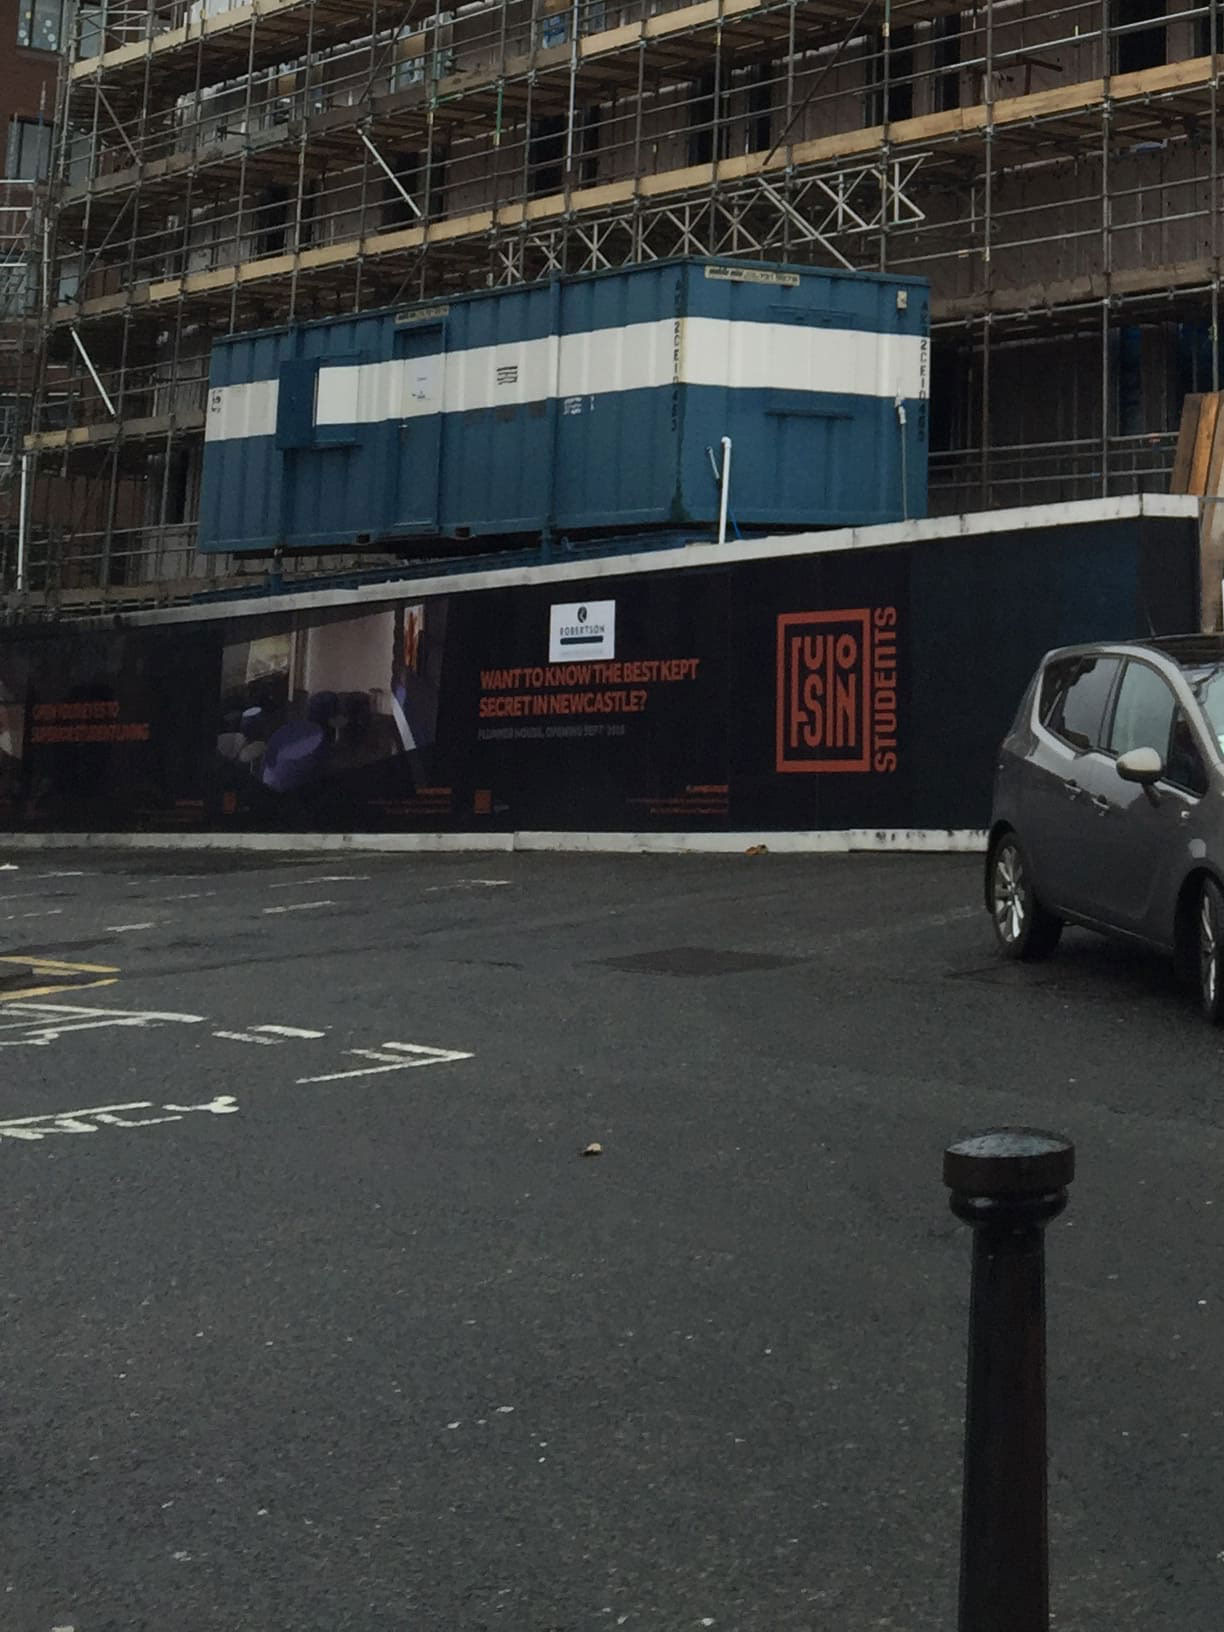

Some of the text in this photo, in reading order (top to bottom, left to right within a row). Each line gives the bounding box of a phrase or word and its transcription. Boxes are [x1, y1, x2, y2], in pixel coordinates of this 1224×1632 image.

[559, 624, 605, 636] ROBERTSON
[479, 658, 700, 689] WANT TO KNOW THE BEST KEPT
[479, 689, 648, 718] SECRET IN NEWCASTLE?
[873, 605, 898, 773] STUDENTS
